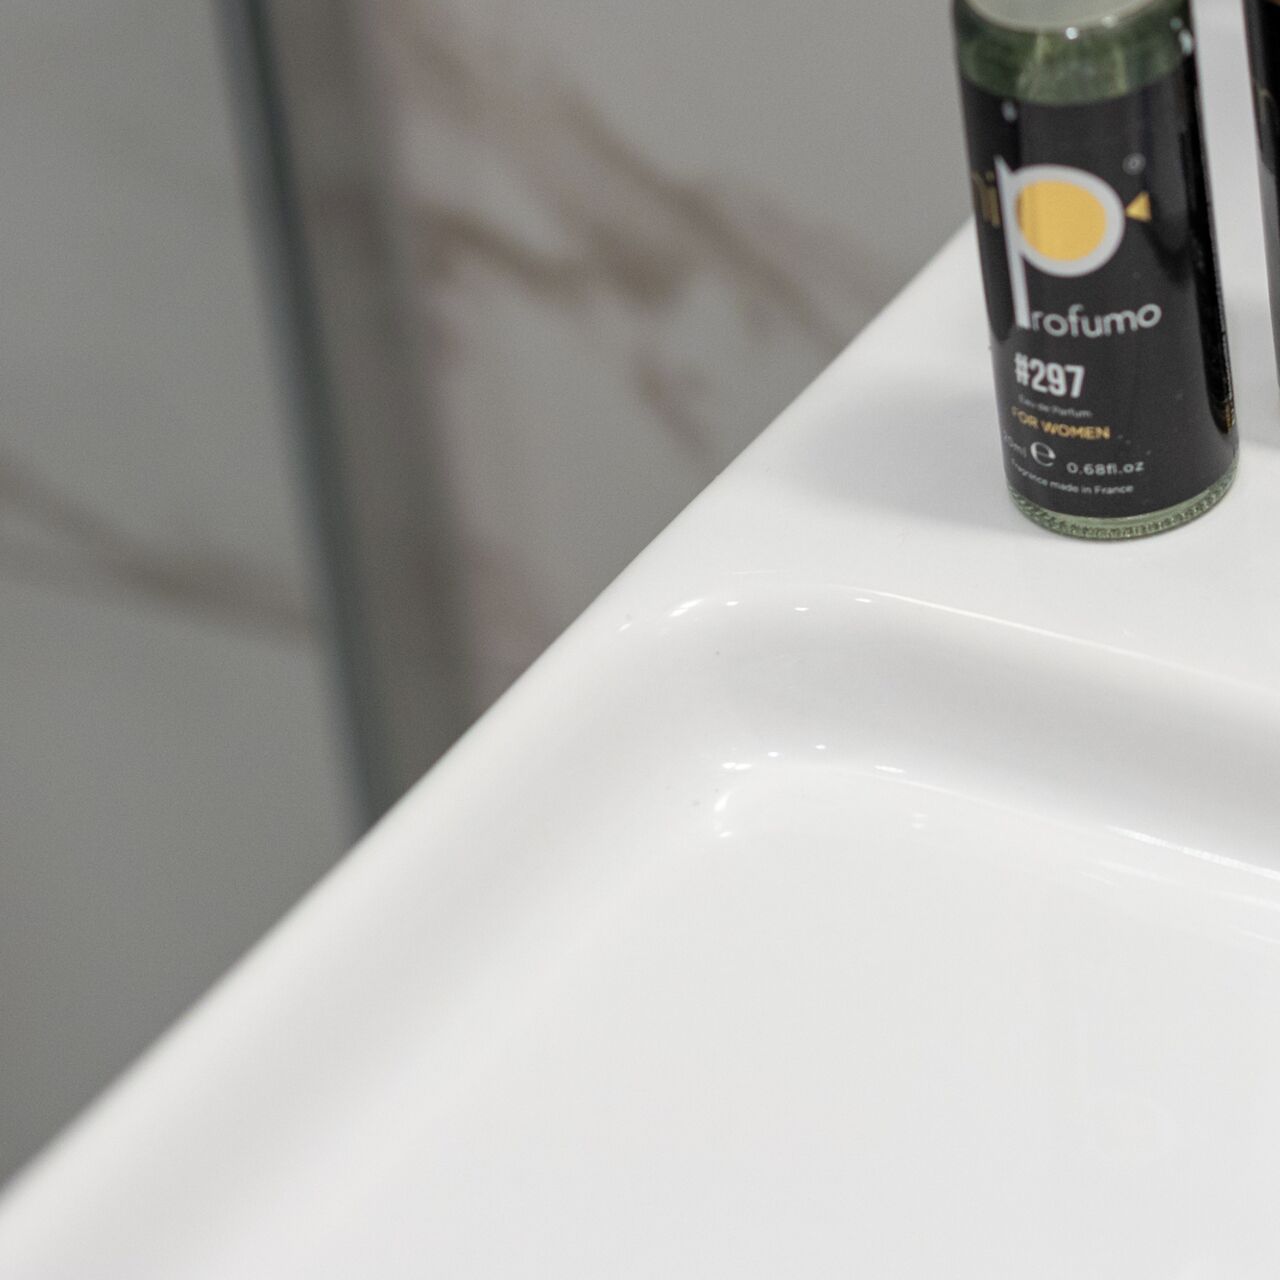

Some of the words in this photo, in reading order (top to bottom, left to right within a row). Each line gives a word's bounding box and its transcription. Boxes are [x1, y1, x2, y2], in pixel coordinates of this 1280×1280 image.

[1014, 351, 1085, 399] #297
[1040, 420, 1112, 441] WOMEN
[1049, 480, 1080, 494] made
[1080, 485, 1093, 495] in
[1093, 484, 1135, 496] France
